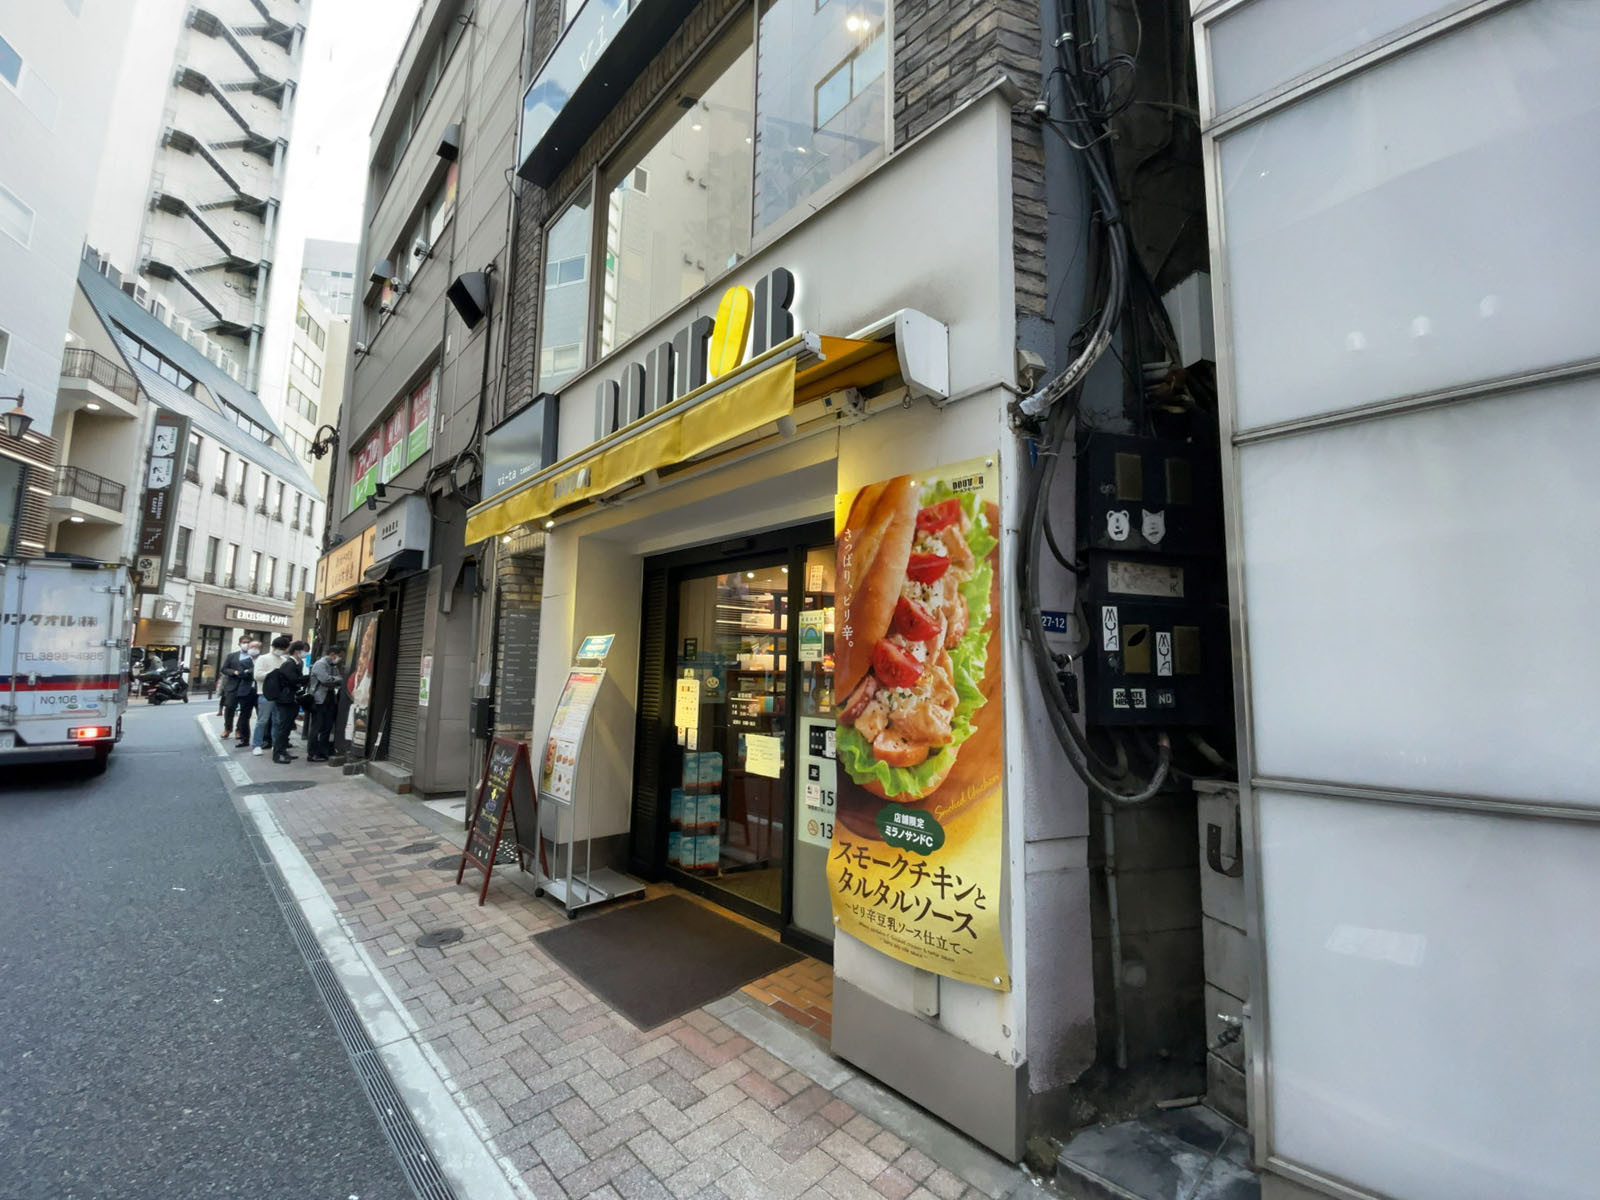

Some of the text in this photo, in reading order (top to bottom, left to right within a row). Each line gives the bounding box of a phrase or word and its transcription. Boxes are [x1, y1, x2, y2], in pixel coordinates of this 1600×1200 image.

[236, 609, 271, 623] EXCELSIOR
[1041, 615, 1066, 629] 27-12
[893, 812, 925, 829] 店舗限定
[820, 822, 833, 840] 13
[884, 825, 934, 848] ミラノサンドC
[834, 840, 987, 910] スモークチキンと
[839, 867, 978, 940] タルタルソース
